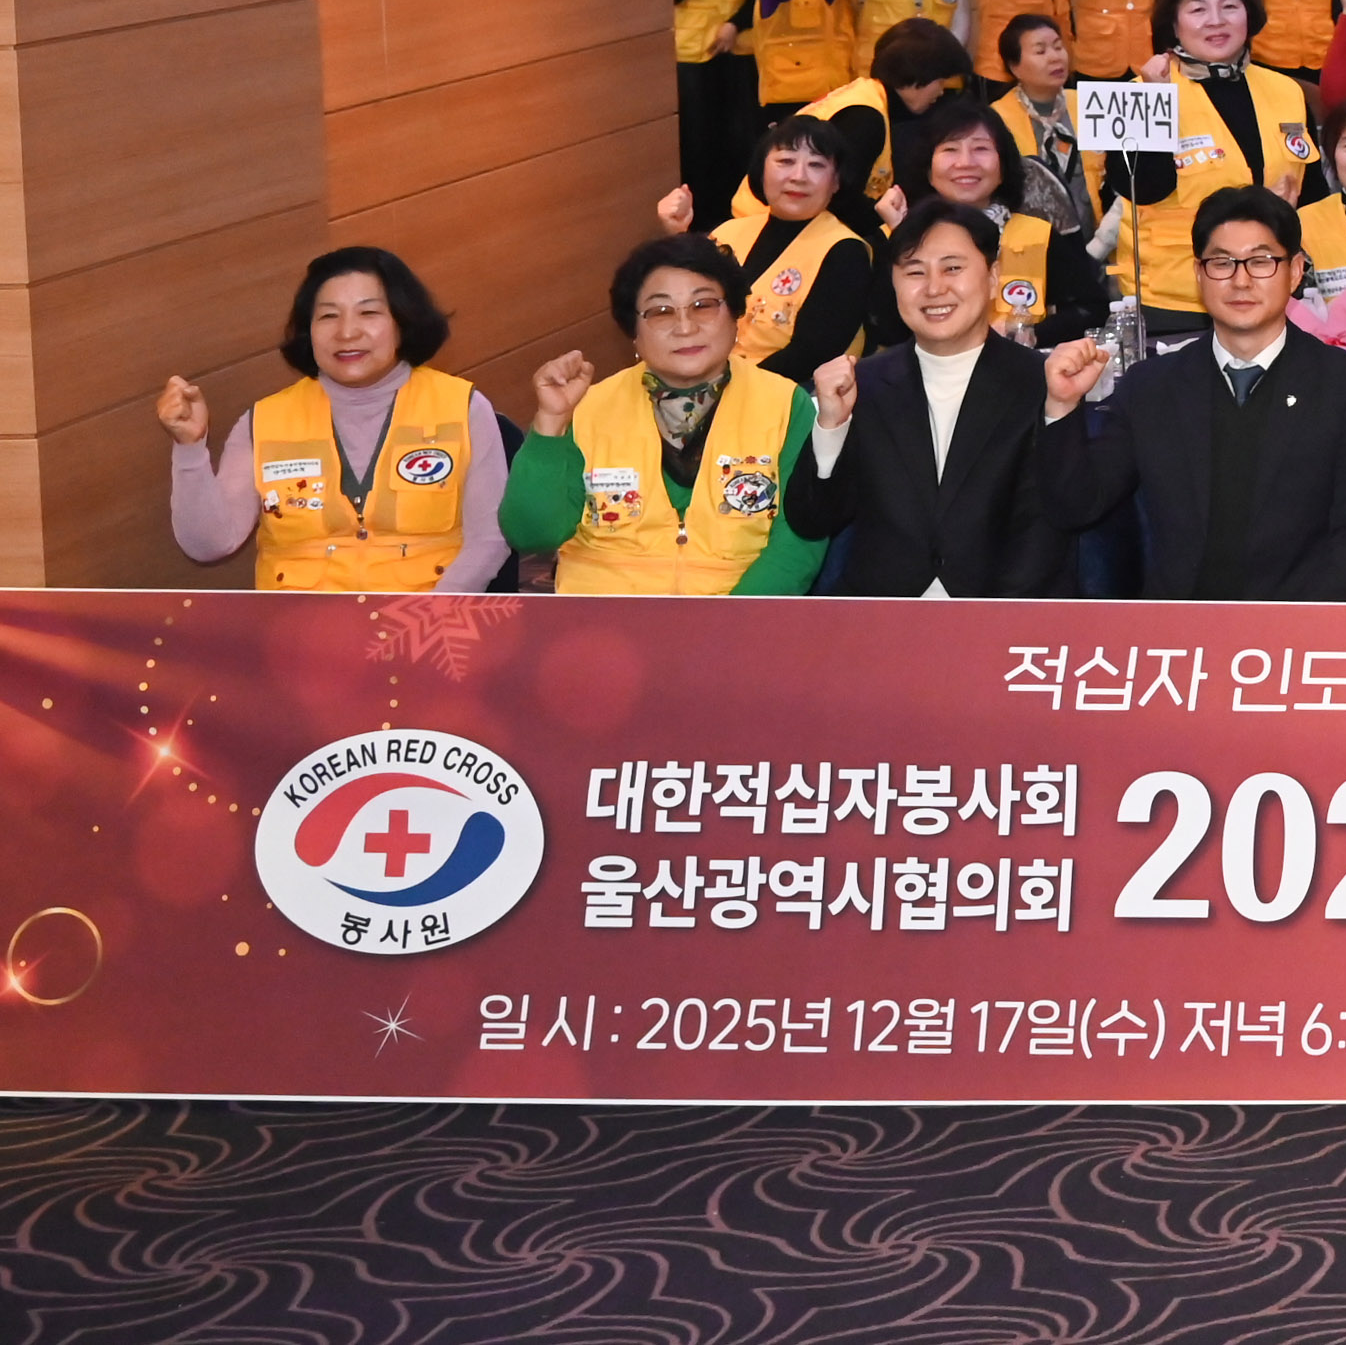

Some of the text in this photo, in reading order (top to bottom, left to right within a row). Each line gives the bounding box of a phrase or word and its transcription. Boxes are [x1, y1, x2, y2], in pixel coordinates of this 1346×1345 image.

[1084, 90, 1172, 139] 수상자석
[1003, 645, 1209, 712] 적십자
[283, 739, 519, 808] KOREAN RED CROSS
[586, 760, 1078, 836] 대한적십자봉사회
[581, 855, 1073, 932] 울산광역시협의회
[636, 997, 831, 1053] 2025년
[846, 998, 955, 1054] 12월
[970, 998, 1166, 1060] 17일(수)
[1179, 1000, 1286, 1057] 저녁
